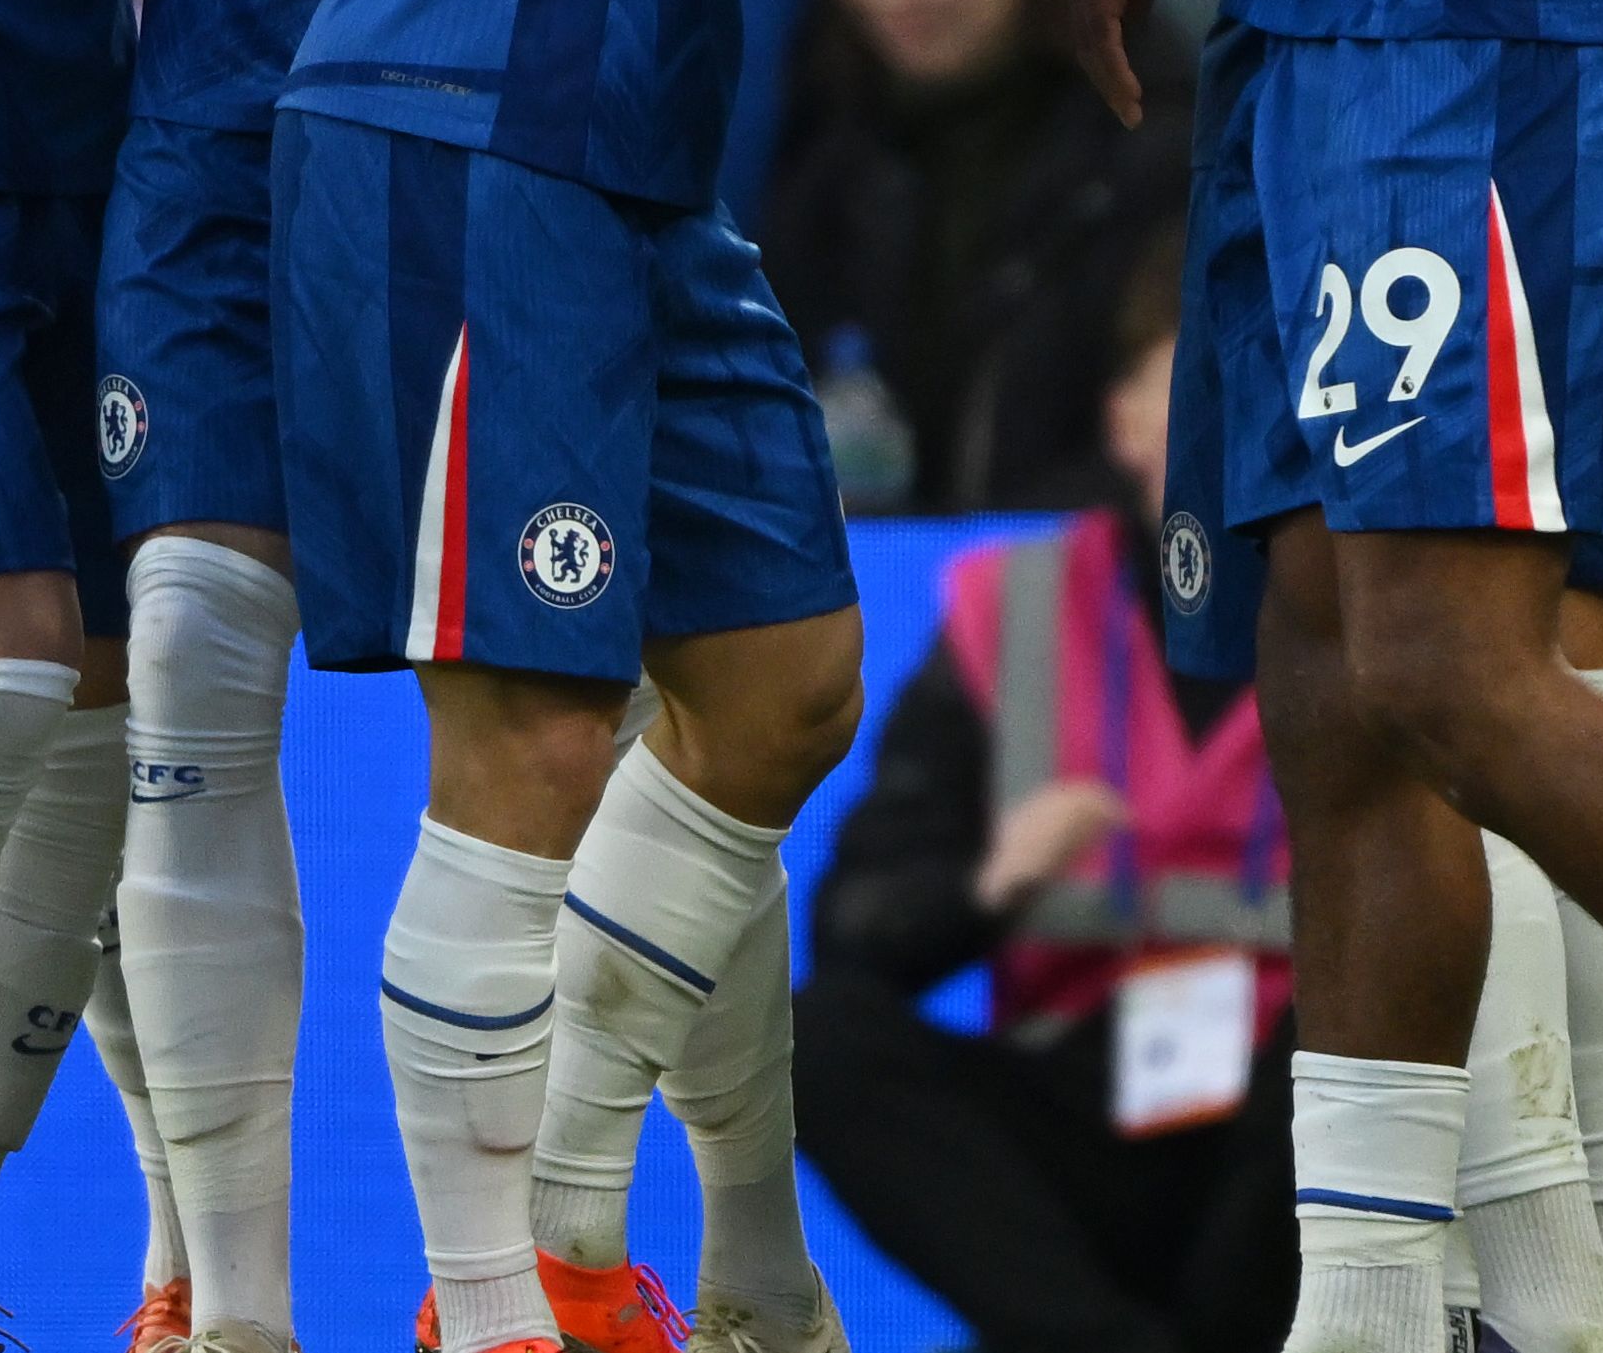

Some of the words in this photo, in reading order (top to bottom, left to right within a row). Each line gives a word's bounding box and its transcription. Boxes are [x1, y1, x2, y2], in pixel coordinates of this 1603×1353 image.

[1298, 247, 1462, 419] 29
[537, 507, 598, 531] CHELSEA
[27, 1004, 78, 1032] CF
